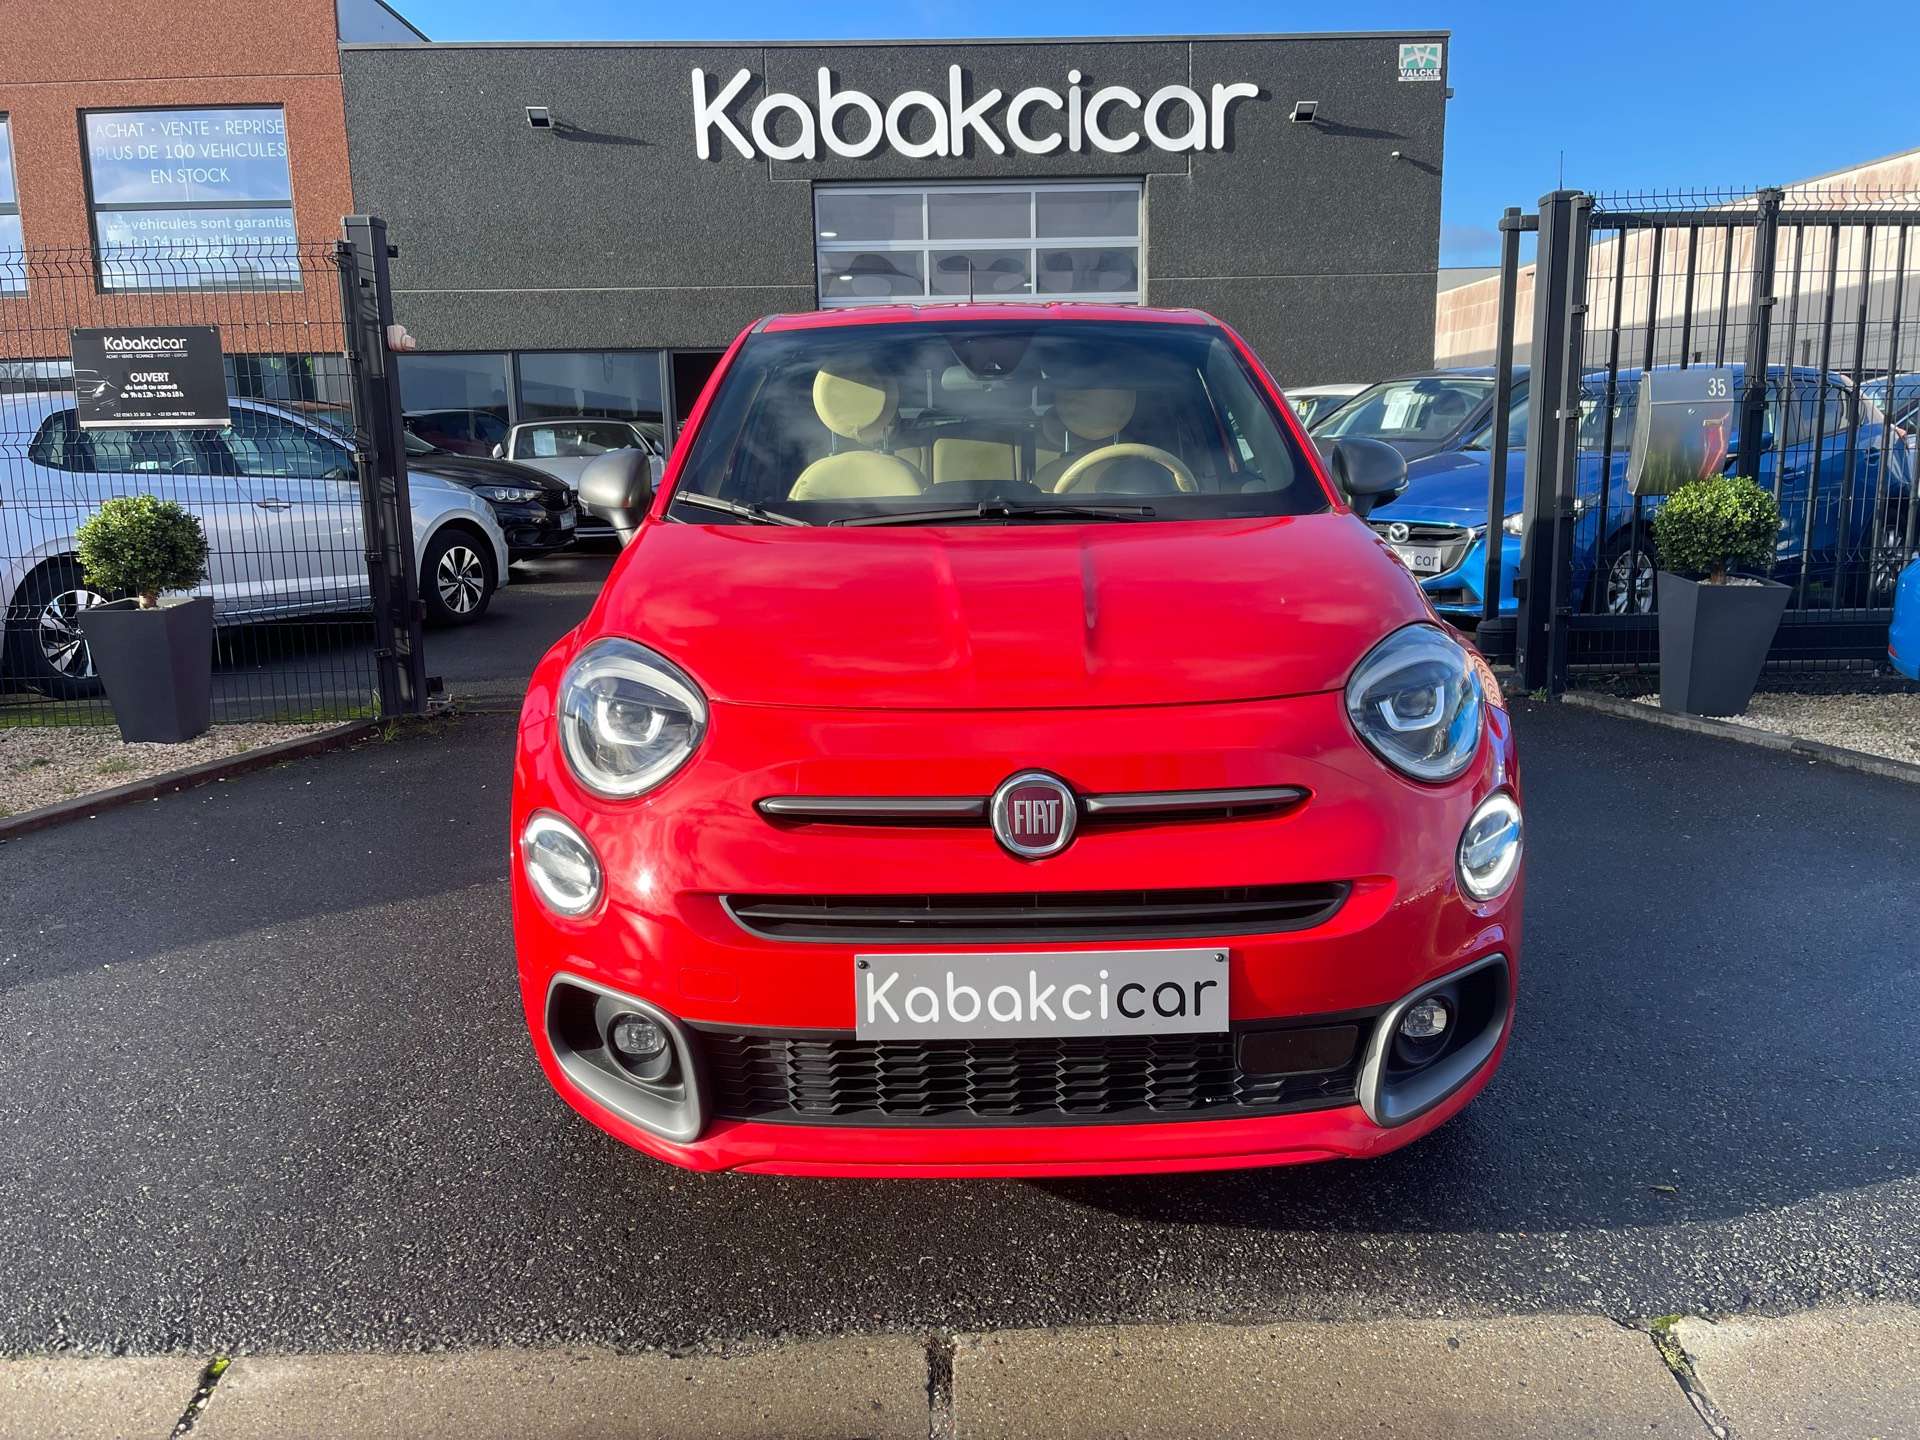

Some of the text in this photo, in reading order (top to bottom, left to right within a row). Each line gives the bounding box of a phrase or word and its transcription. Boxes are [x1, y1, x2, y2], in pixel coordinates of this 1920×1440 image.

[1400, 68, 1440, 77] VALCKE
[691, 64, 1259, 161] Kabakcicar
[96, 119, 285, 138] ACHAT VENTE REPRISE
[96, 142, 286, 161] PLUS DE 100 VEHICULES
[151, 167, 231, 184] EN STOCK
[131, 217, 197, 231] véhicules
[201, 217, 232, 229] sont
[234, 215, 292, 231] garantis
[103, 335, 188, 351] Kabakcicar
[130, 372, 169, 383] OUVERT
[1707, 377, 1726, 397] 35
[1013, 799, 1060, 835] FIAT
[866, 969, 1218, 1024] Kabakcicar
